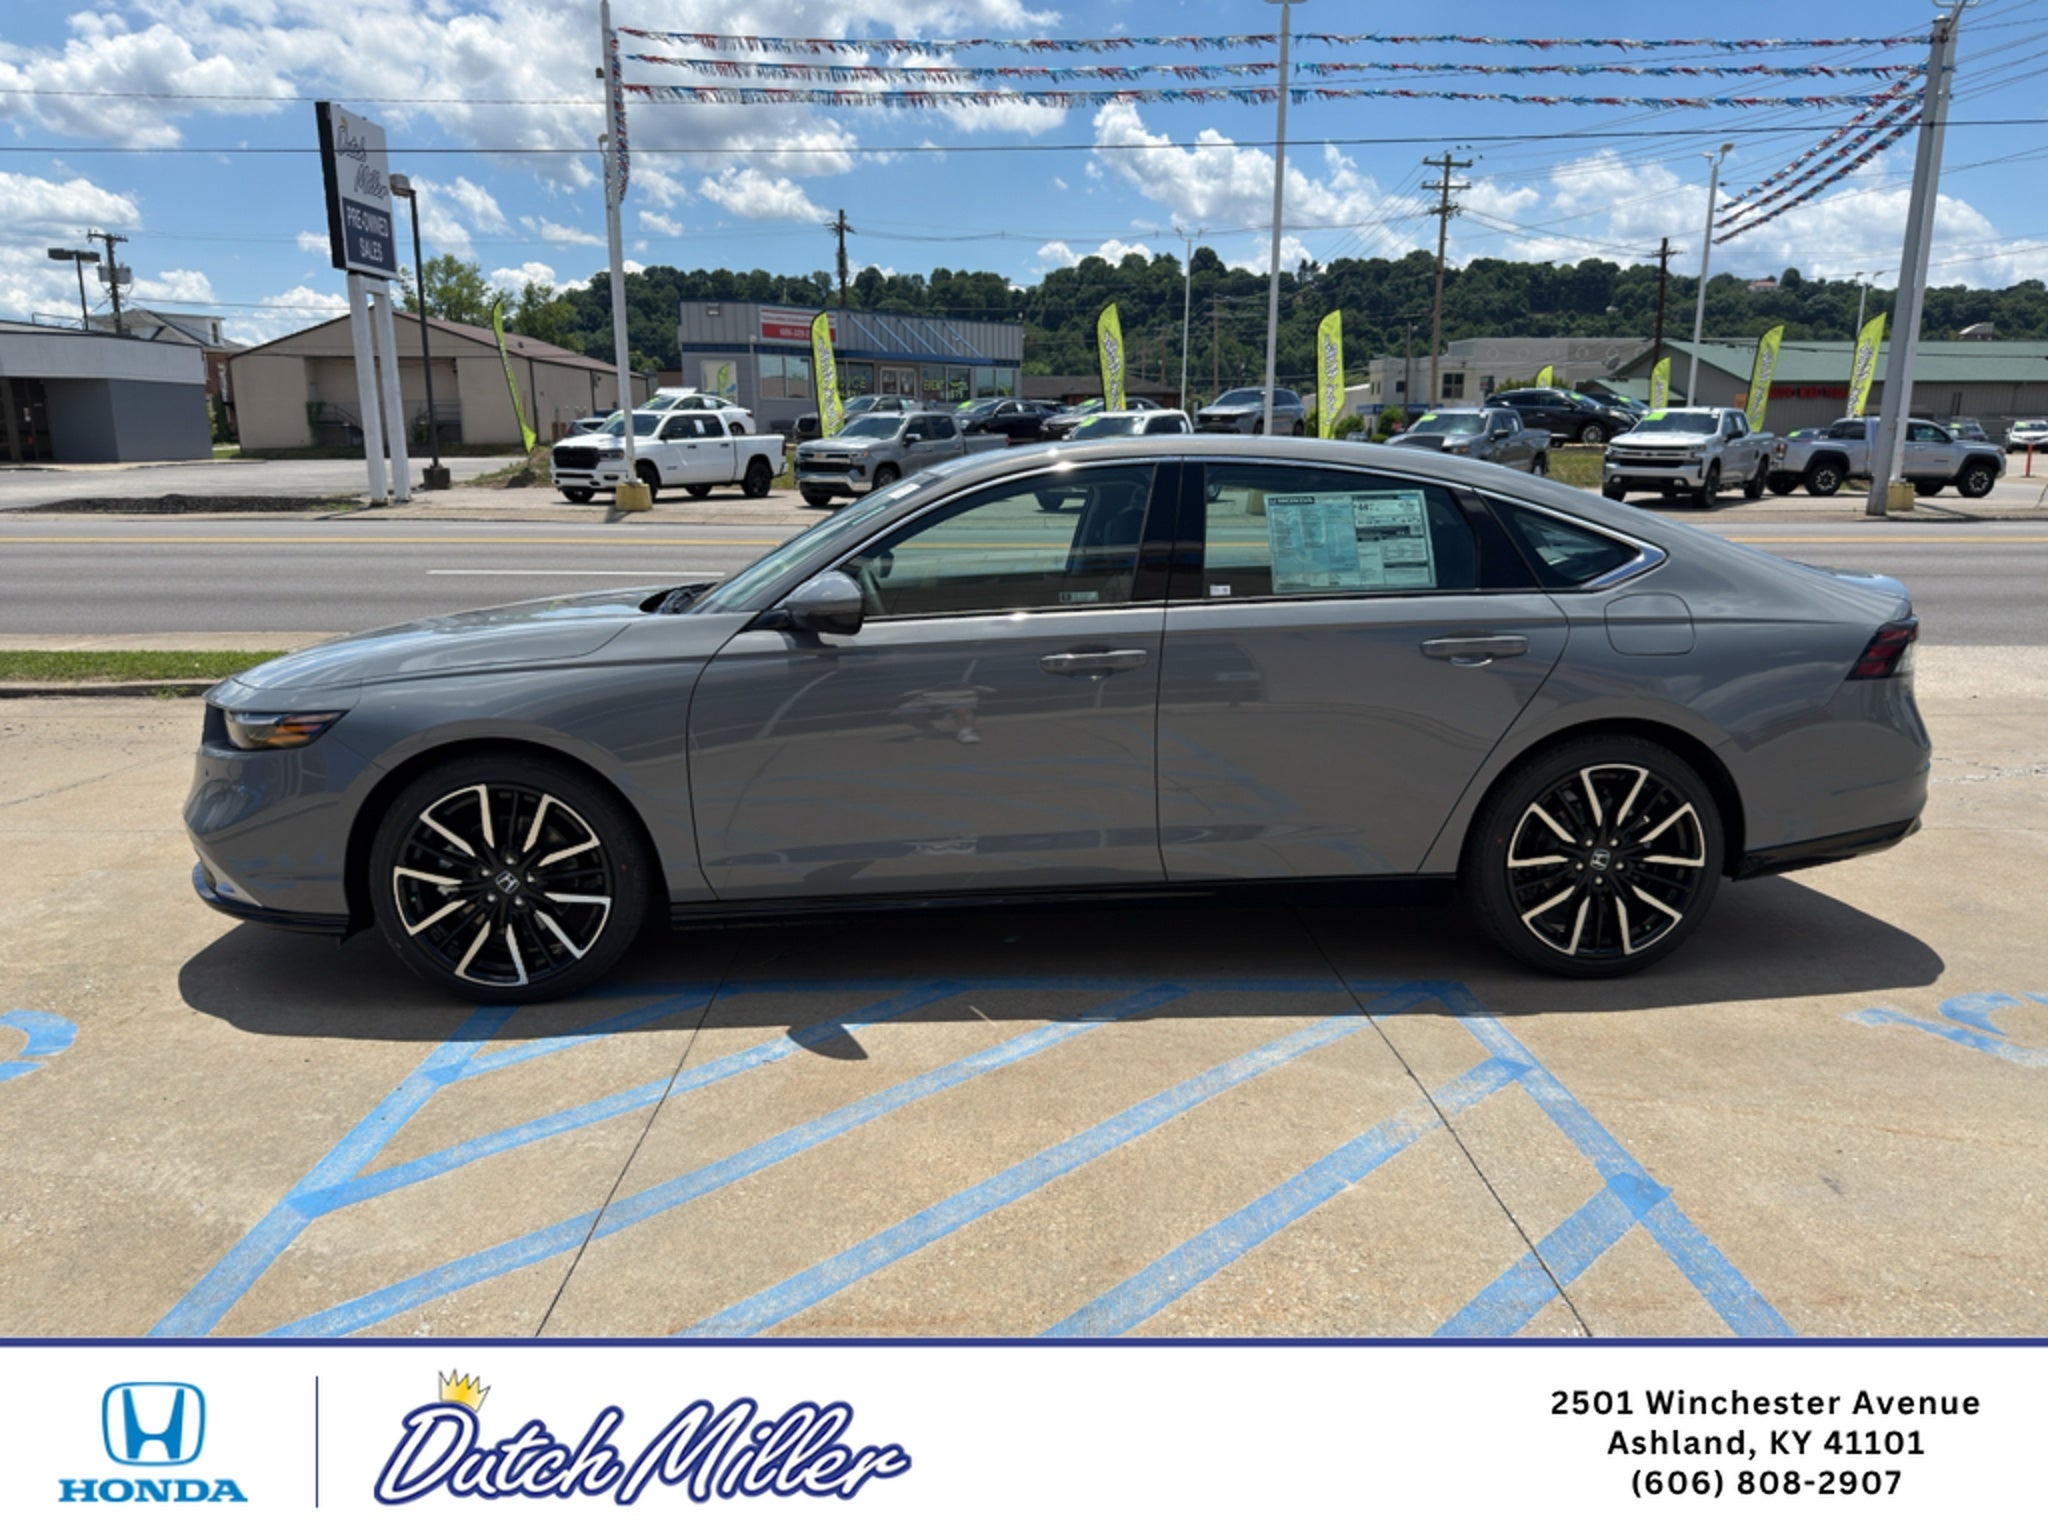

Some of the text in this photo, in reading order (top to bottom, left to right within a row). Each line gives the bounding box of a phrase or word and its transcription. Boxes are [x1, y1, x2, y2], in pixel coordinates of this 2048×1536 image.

[354, 164, 390, 201] Miller
[346, 205, 390, 238] PRE-OWNED
[359, 238, 384, 263] SALES
